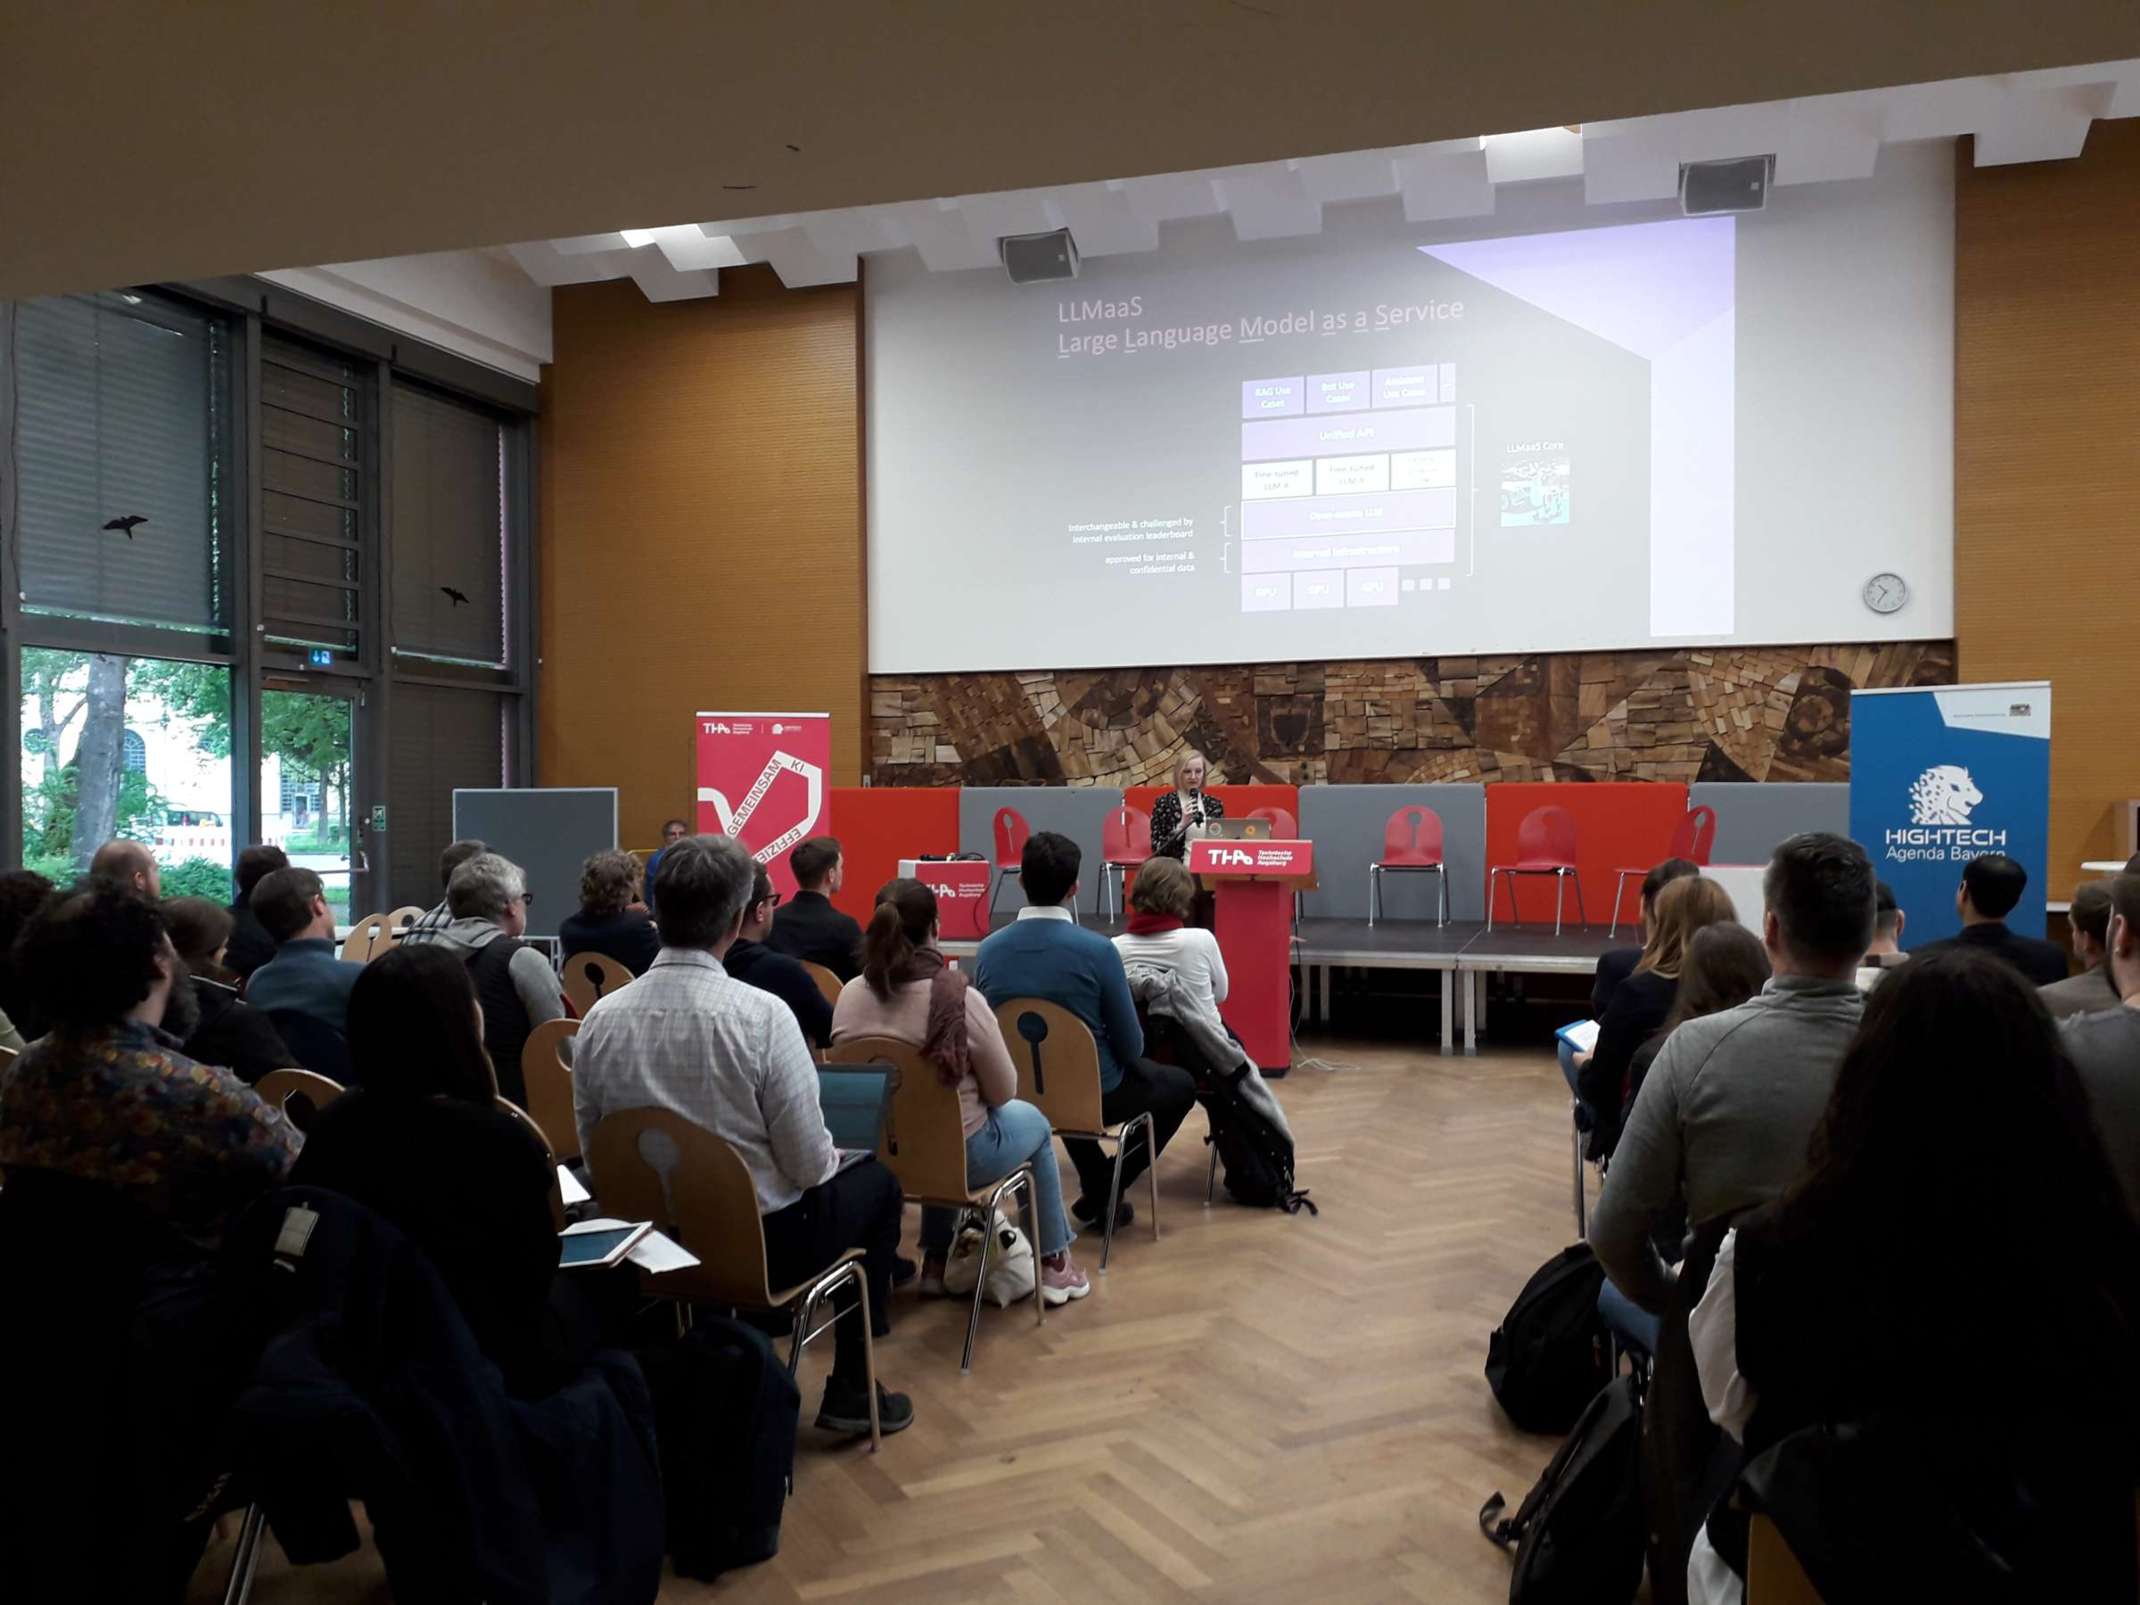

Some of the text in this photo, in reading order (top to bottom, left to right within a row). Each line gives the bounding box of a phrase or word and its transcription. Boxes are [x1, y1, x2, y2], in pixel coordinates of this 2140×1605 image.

[1058, 296, 1143, 323] LLMaaS
[1058, 299, 1464, 357] Large Language Model as a Service
[790, 759, 805, 773] KI
[727, 758, 782, 836] GEMEINSAM
[1885, 828, 2007, 846] HIGHTECH
[1885, 845, 1945, 863] Agenda
